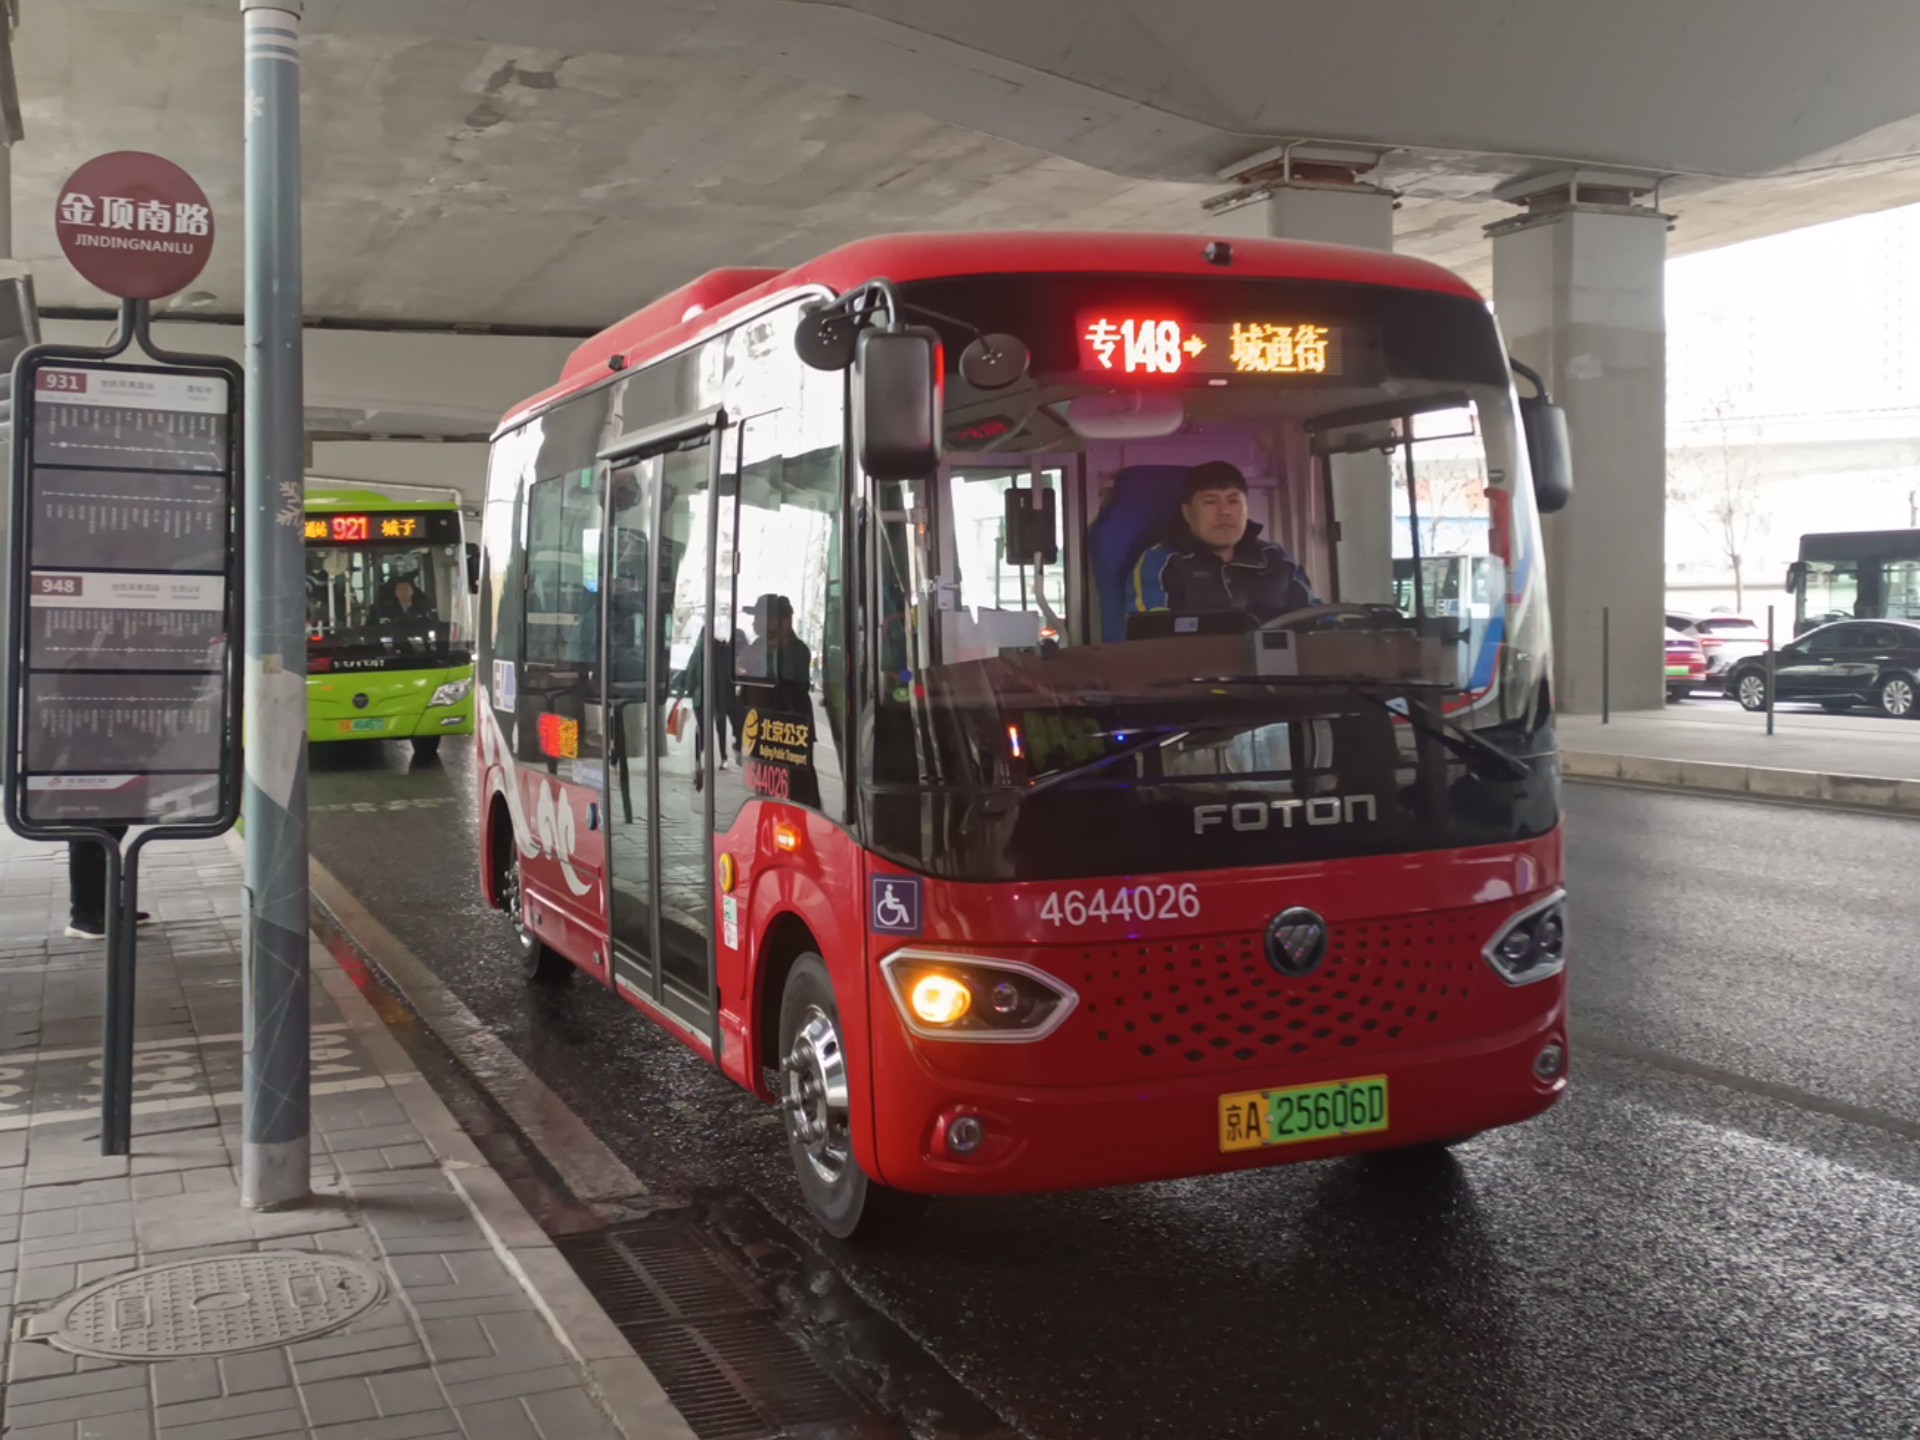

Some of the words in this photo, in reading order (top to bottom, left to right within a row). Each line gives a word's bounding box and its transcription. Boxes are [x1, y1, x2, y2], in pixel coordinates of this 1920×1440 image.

[59, 192, 209, 236] 金顶南路
[74, 233, 194, 255] JINDINGNANLU
[1229, 322, 1329, 373] 城通街
[46, 373, 79, 391] 931
[332, 516, 369, 540] 921
[381, 518, 416, 537] 城子
[42, 579, 75, 594] 948
[761, 719, 808, 747] 北京公交
[1193, 794, 1377, 835] FOTON
[1039, 882, 1201, 928] 4644026
